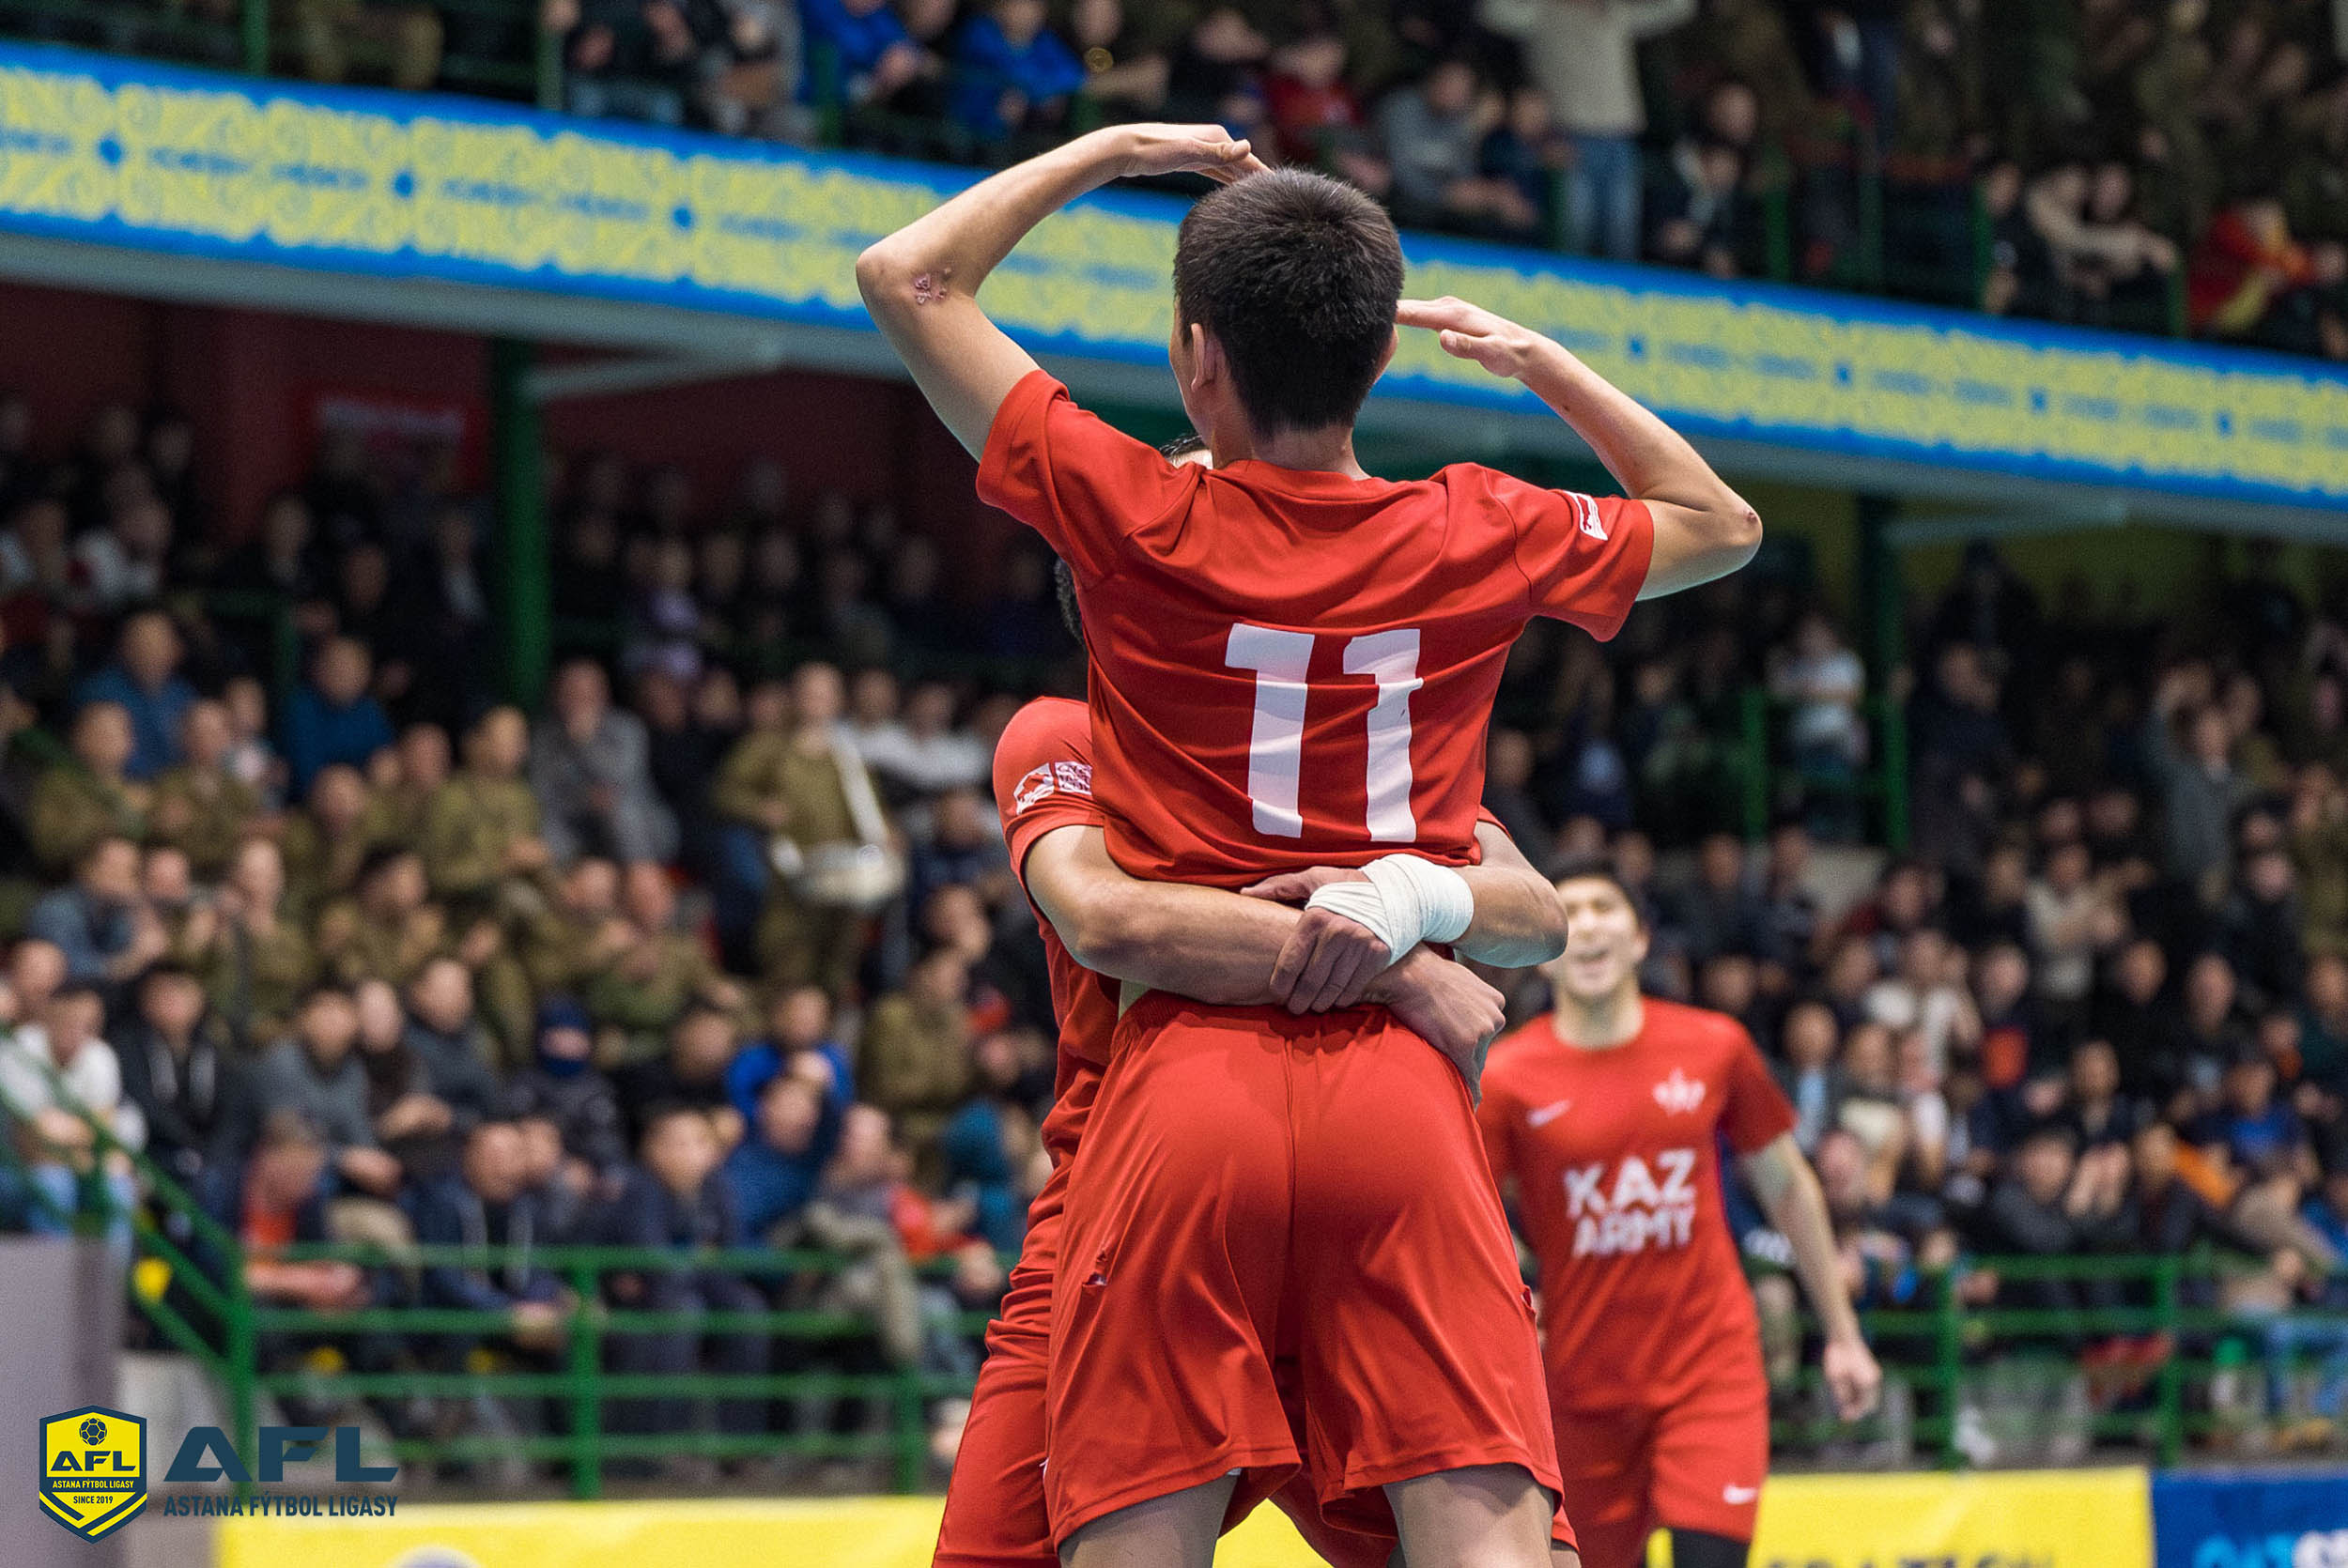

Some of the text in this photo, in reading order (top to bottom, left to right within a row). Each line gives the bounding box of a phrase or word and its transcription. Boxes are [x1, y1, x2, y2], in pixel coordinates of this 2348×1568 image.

[1225, 623, 1424, 842] 11
[1563, 1148, 1697, 1220] KAZ
[1572, 1204, 1697, 1259] ARMY
